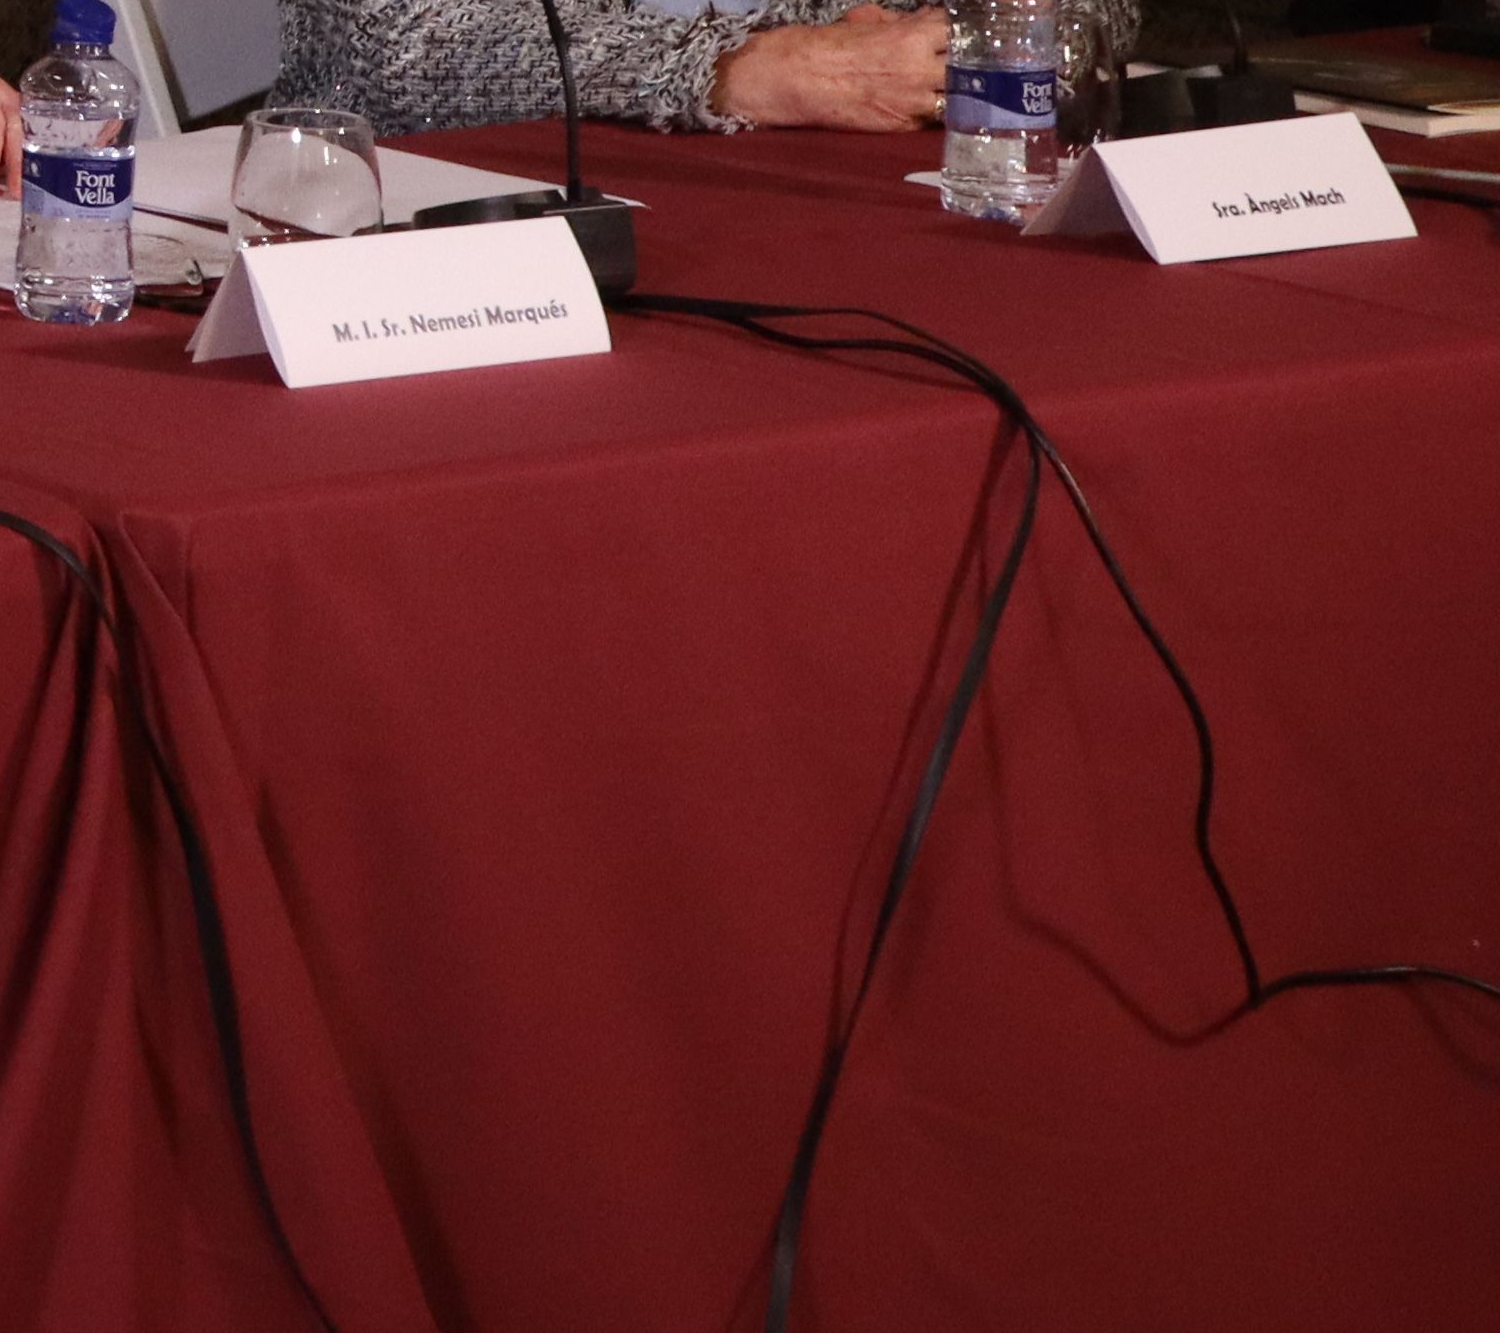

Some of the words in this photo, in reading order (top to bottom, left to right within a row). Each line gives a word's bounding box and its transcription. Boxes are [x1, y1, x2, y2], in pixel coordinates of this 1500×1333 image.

[75, 170, 116, 188] Font
[74, 186, 116, 205] Vella
[1212, 200, 1246, 219] Sra.
[1244, 191, 1300, 215] Àngels
[332, 321, 359, 343] M.
[361, 320, 378, 340] I.
[381, 318, 406, 338] Sr.
[408, 309, 482, 335] Nemesi
[483, 299, 569, 326] Marqués
